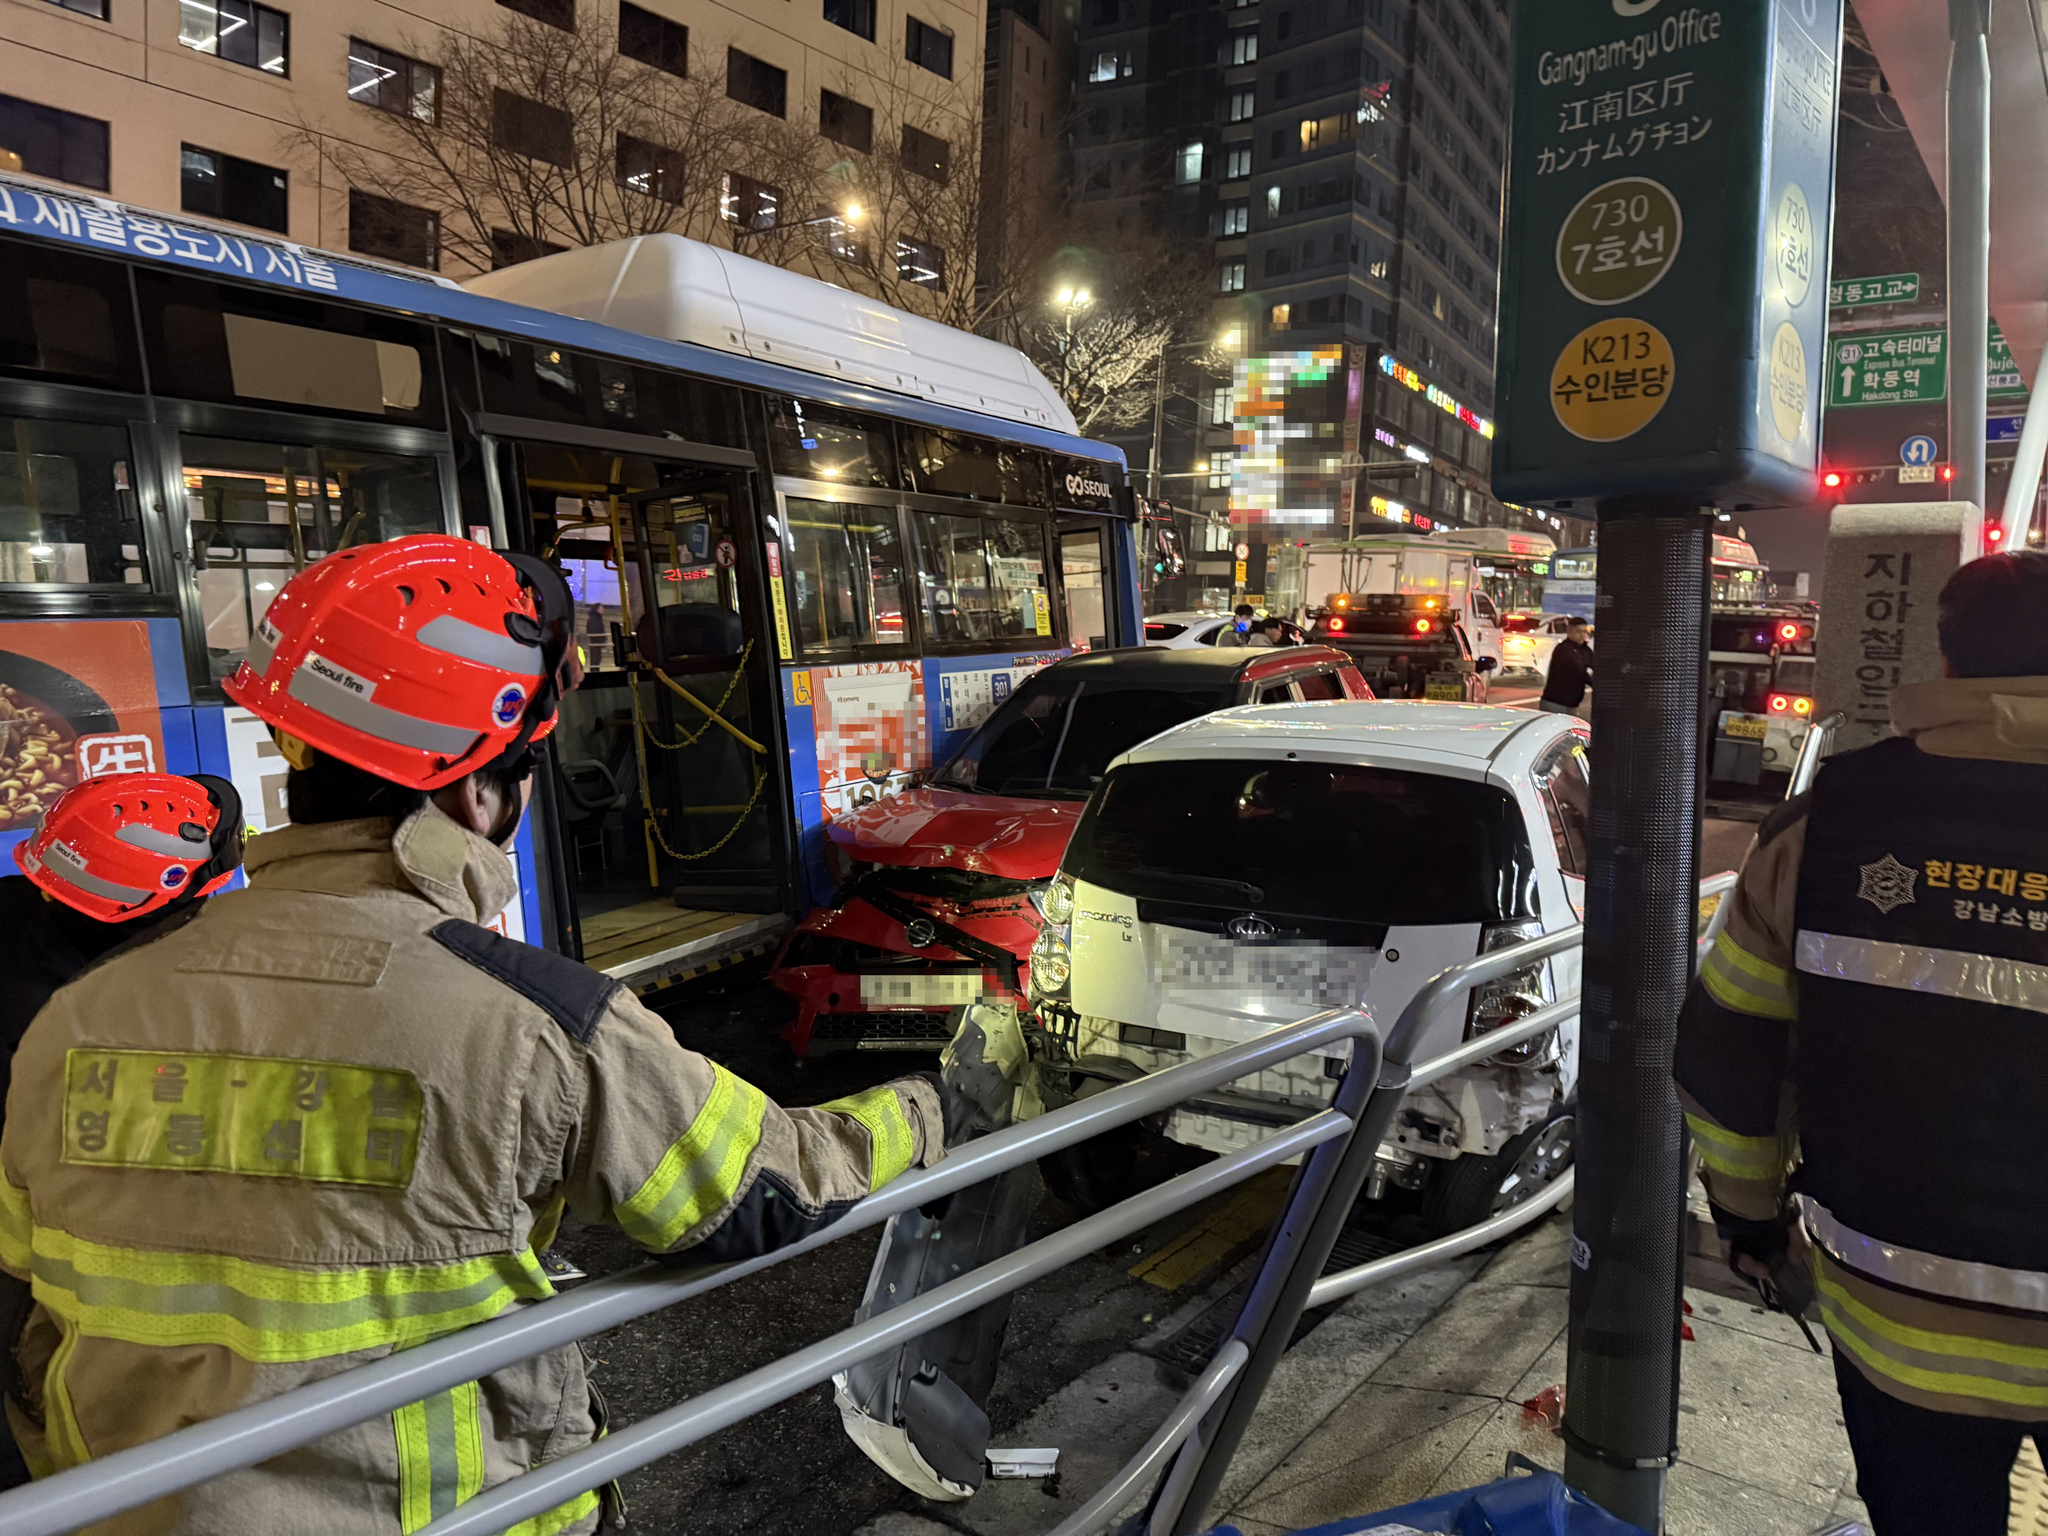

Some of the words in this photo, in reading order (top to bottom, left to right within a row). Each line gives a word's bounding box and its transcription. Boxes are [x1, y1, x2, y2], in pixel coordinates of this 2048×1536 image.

[1538, 31, 1660, 86] Gangnam-gu
[1660, 7, 1722, 52] Office
[1557, 70, 1694, 134] 江南区厅
[1535, 118, 1713, 176] カンナムグチョン
[1590, 194, 1650, 232] 730
[1785, 195, 1806, 235] 730
[265, 245, 339, 291] 서울
[1571, 226, 1664, 275] 7호선
[1582, 331, 1651, 366] K213
[1843, 349, 1857, 360] 31
[1863, 334, 1942, 358] 고속터미널
[1863, 360, 1890, 370] Express
[1891, 357, 1905, 368] Bus
[1906, 356, 1937, 366] Terminal
[1554, 364, 1670, 406] 수인분당
[1861, 391, 1901, 402] Hakdong
[1902, 389, 1918, 399] Stn
[1863, 368, 1920, 390] 학동역
[1065, 473, 1084, 497] GO
[1083, 479, 1113, 499] SEOUL
[310, 658, 343, 684] Seoul
[343, 674, 365, 695] fire
[994, 680, 1009, 698] 301
[54, 842, 71, 861] Seoul
[69, 852, 82, 866] fire
[1925, 859, 2048, 902] 현장대응
[1078, 910, 1134, 929] morning
[1953, 899, 2048, 932] 강남소방
